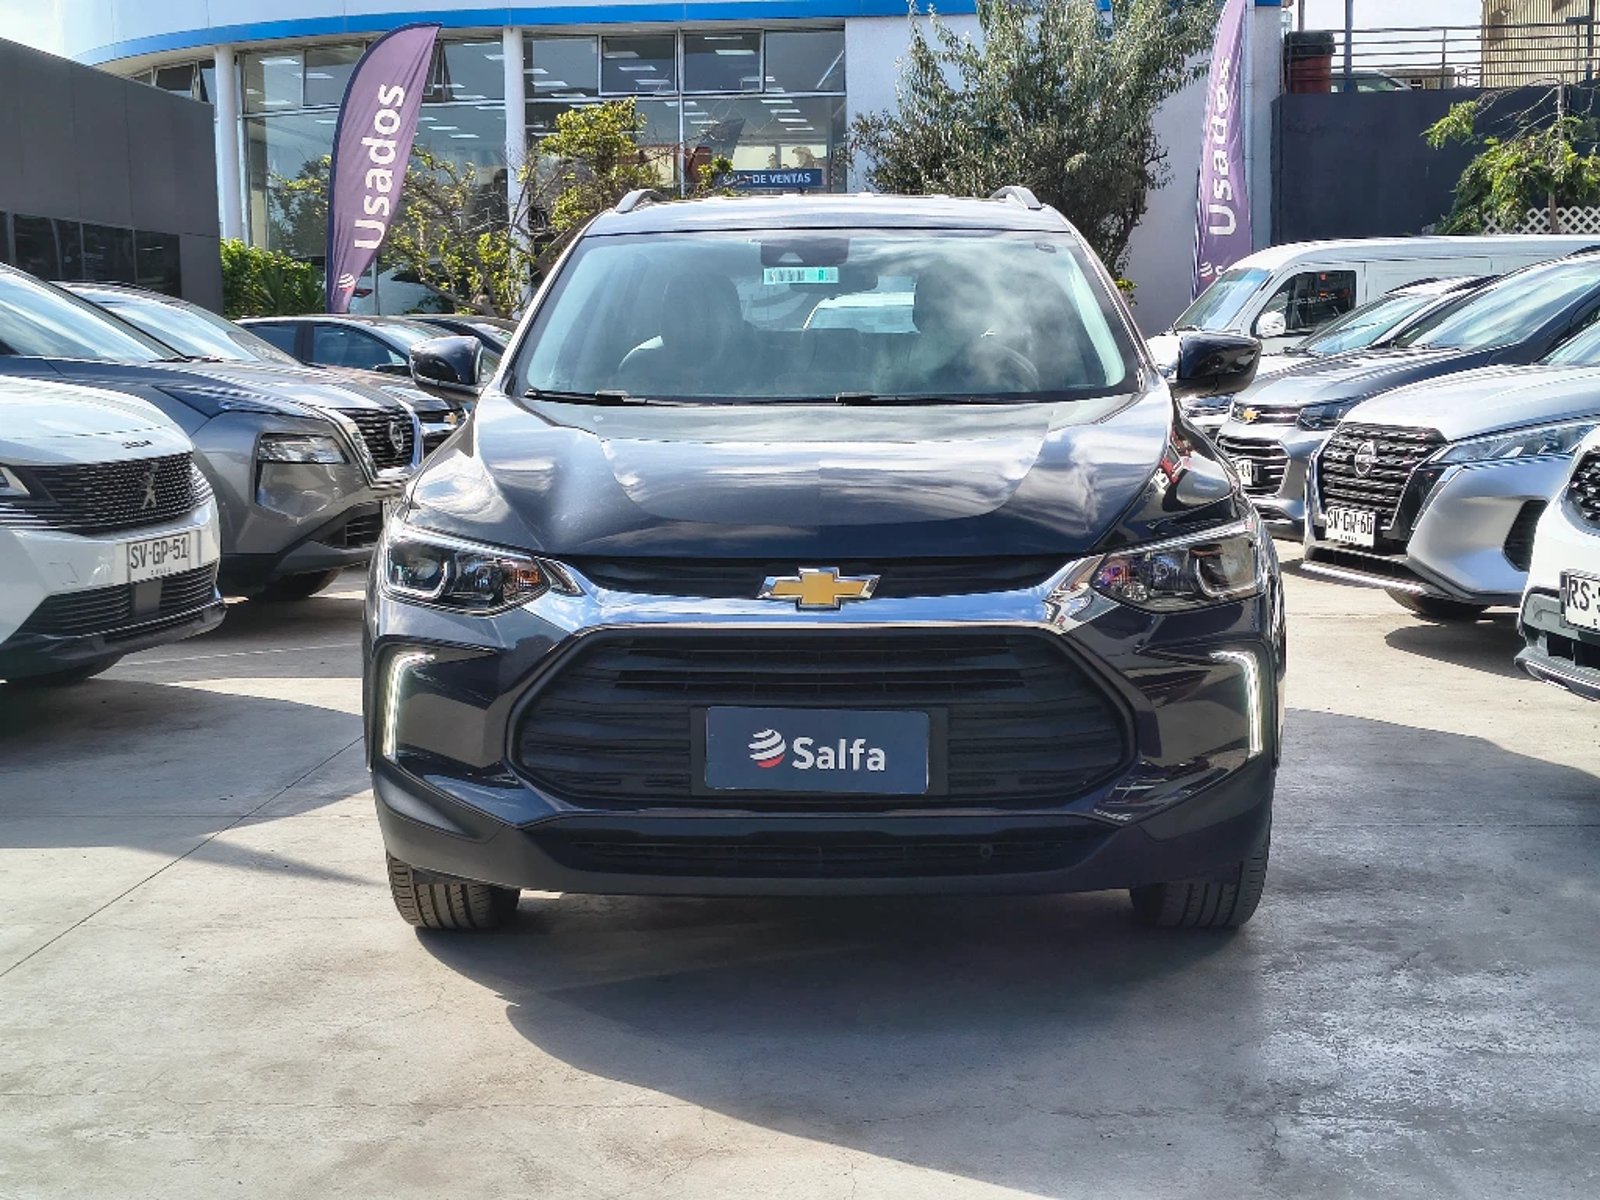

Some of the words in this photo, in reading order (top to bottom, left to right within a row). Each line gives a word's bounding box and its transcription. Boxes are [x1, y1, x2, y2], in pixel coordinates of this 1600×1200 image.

[354, 84, 405, 249] Usados
[752, 174, 767, 184] DE
[769, 172, 811, 184] VENTAS
[1209, 56, 1237, 236] Usados
[792, 737, 885, 771] Salfa
